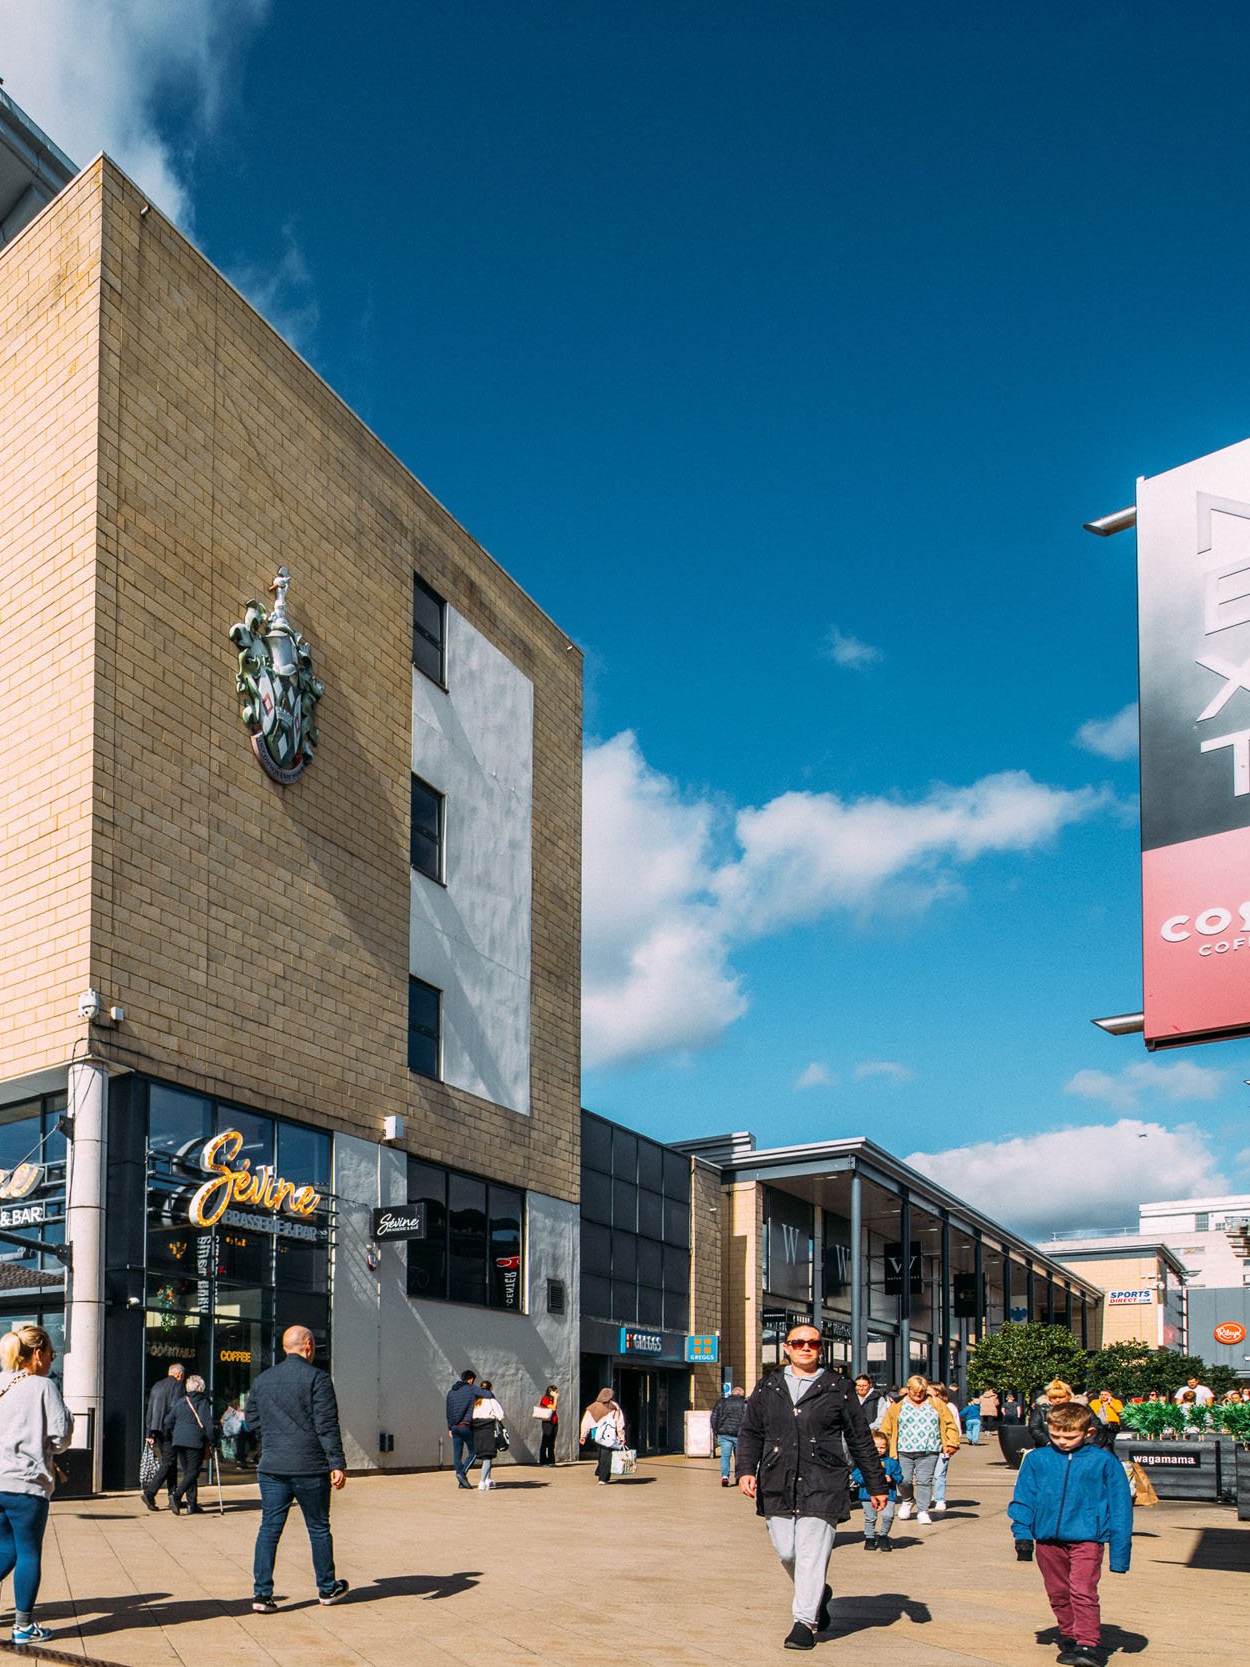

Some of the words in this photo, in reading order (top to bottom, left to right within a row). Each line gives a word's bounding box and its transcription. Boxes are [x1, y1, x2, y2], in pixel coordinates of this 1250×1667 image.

[1198, 937, 1250, 956] COF
[189, 1131, 320, 1227] Sévine
[12, 1206, 43, 1226] BAR
[377, 1213, 419, 1235] Sévine
[782, 1224, 800, 1266] W
[1110, 1290, 1150, 1299] SPORTS
[633, 1334, 661, 1352] GREGGS
[220, 1350, 251, 1364] COFFEE
[1133, 1455, 1196, 1465] wagamama
